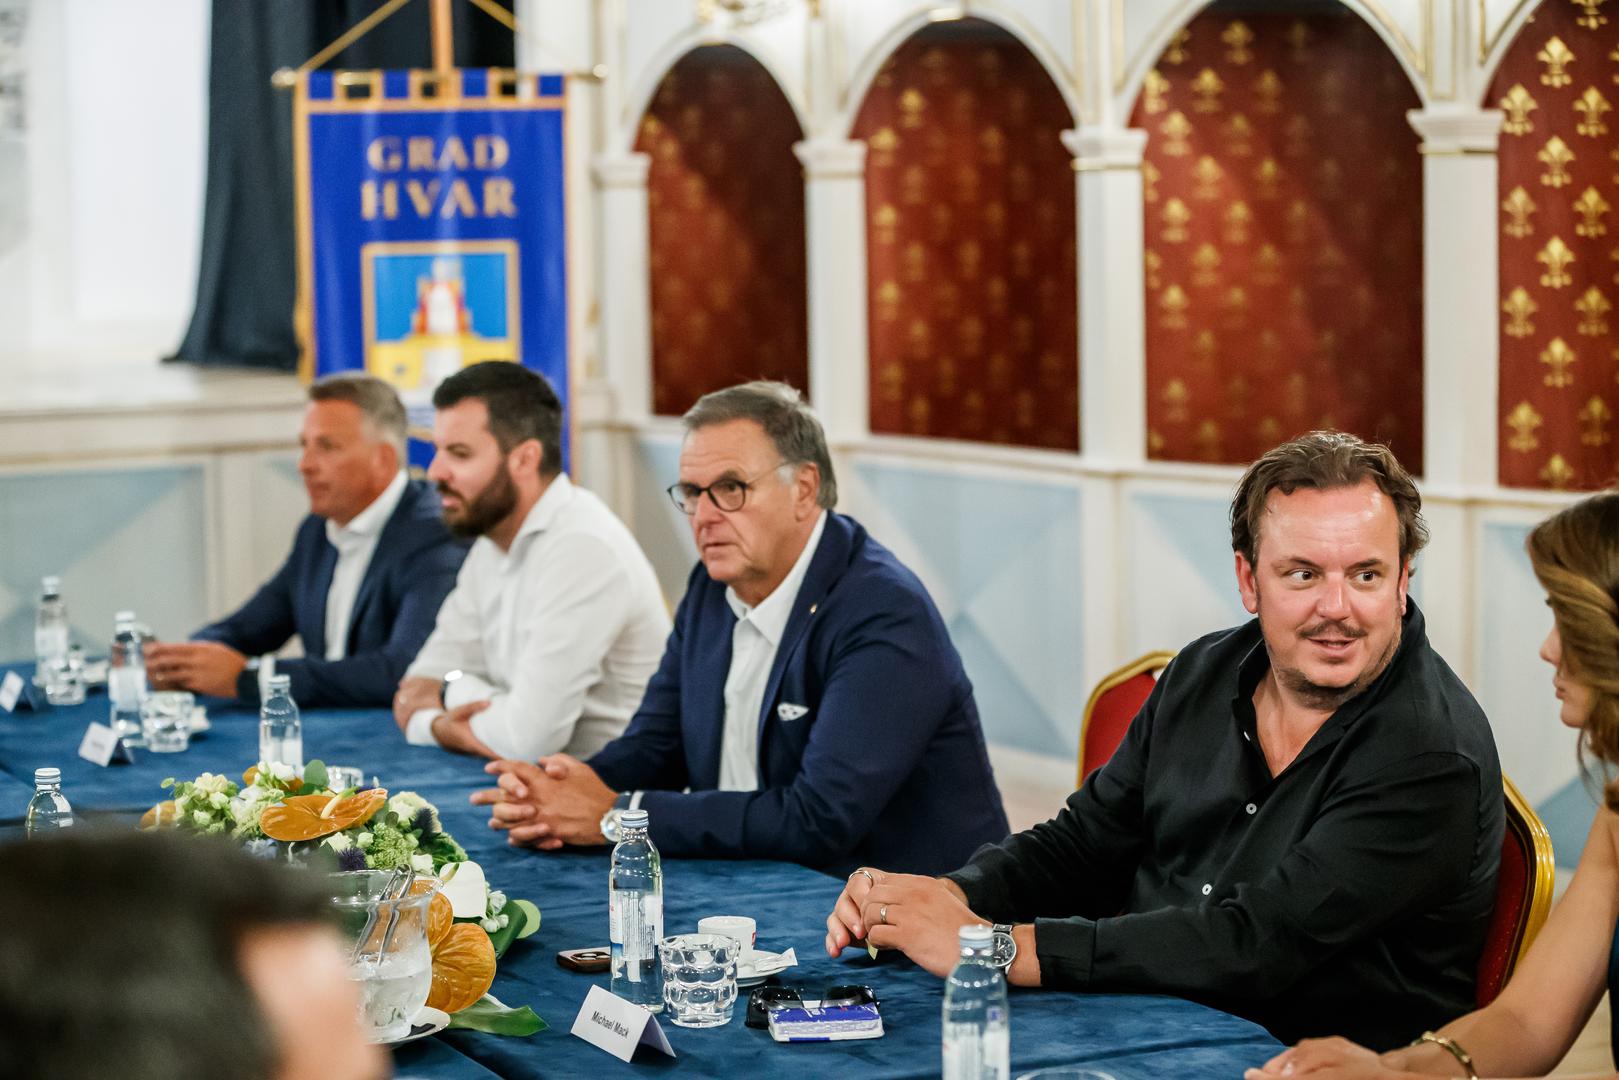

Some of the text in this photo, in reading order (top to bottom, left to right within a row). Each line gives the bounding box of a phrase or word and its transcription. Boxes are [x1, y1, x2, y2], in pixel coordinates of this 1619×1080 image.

[367, 135, 509, 172] GRAD
[361, 178, 517, 220] HVAR
[592, 1011, 630, 1038] Michael Mack
